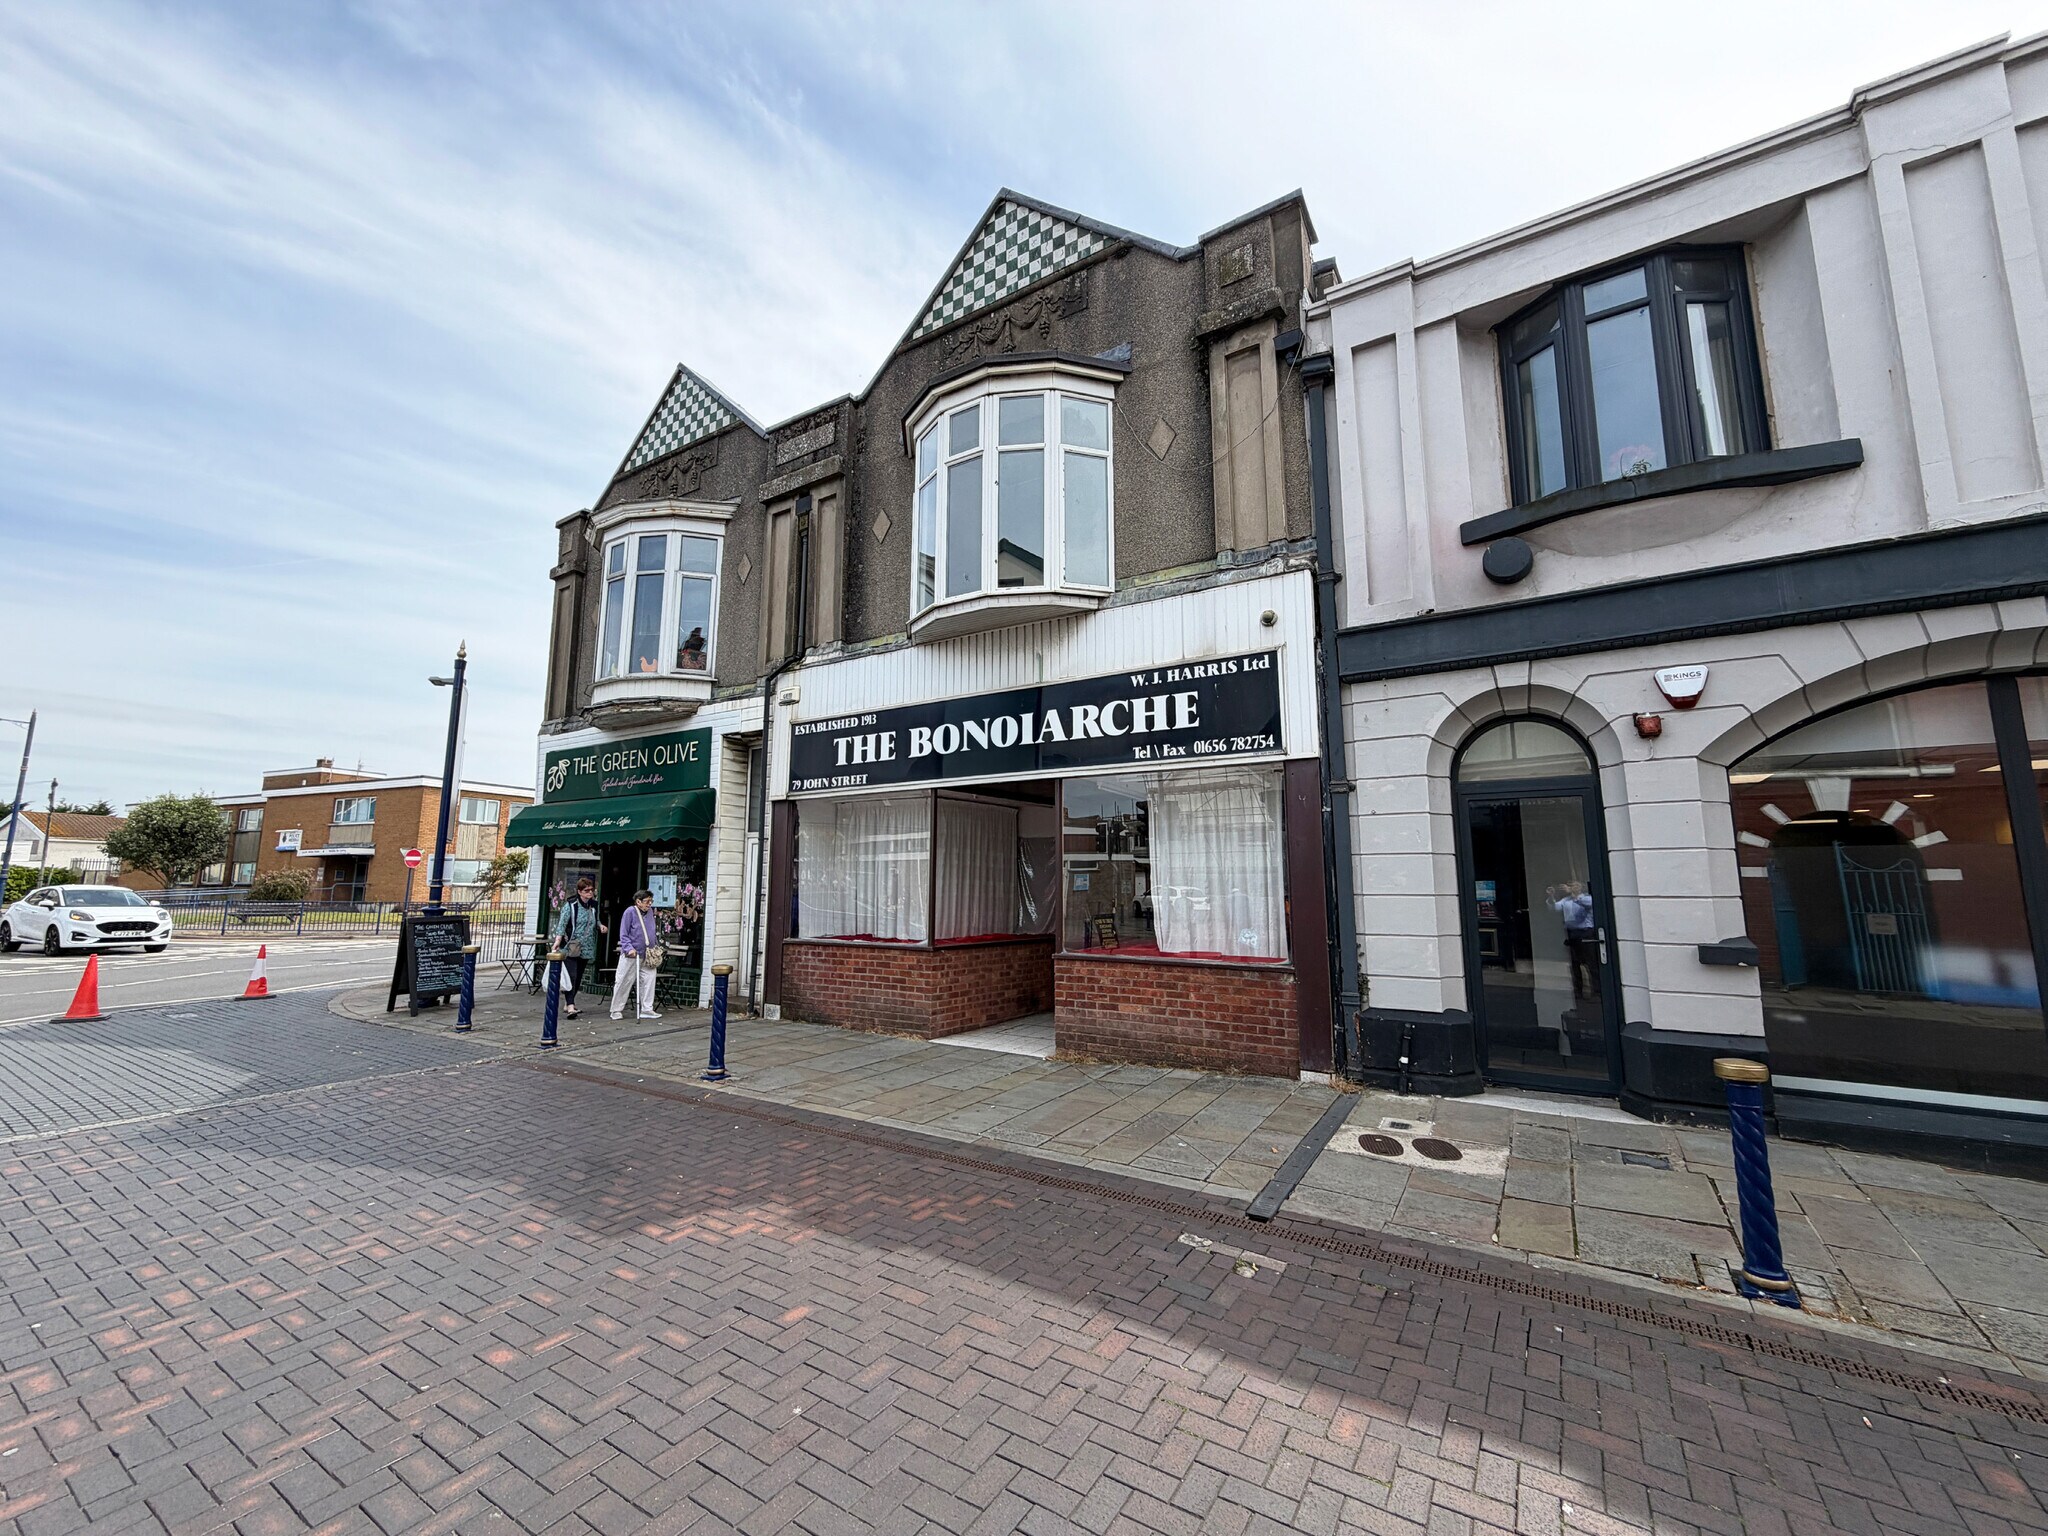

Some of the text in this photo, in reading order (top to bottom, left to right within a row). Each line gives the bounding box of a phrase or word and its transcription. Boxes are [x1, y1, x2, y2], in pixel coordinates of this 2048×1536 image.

[1130, 655, 1271, 688] W. J. HARRIS Ltd
[794, 714, 877, 736] ESTABLISHED 1913
[573, 741, 699, 776] THE GREEN OLIVE
[833, 730, 896, 767] THE
[1133, 745, 1151, 760] Tel
[1163, 743, 1187, 757] Fax
[1193, 737, 1227, 755] 01656
[1230, 734, 1275, 751] 782754
[792, 773, 868, 791] 79 JOHN STREET
